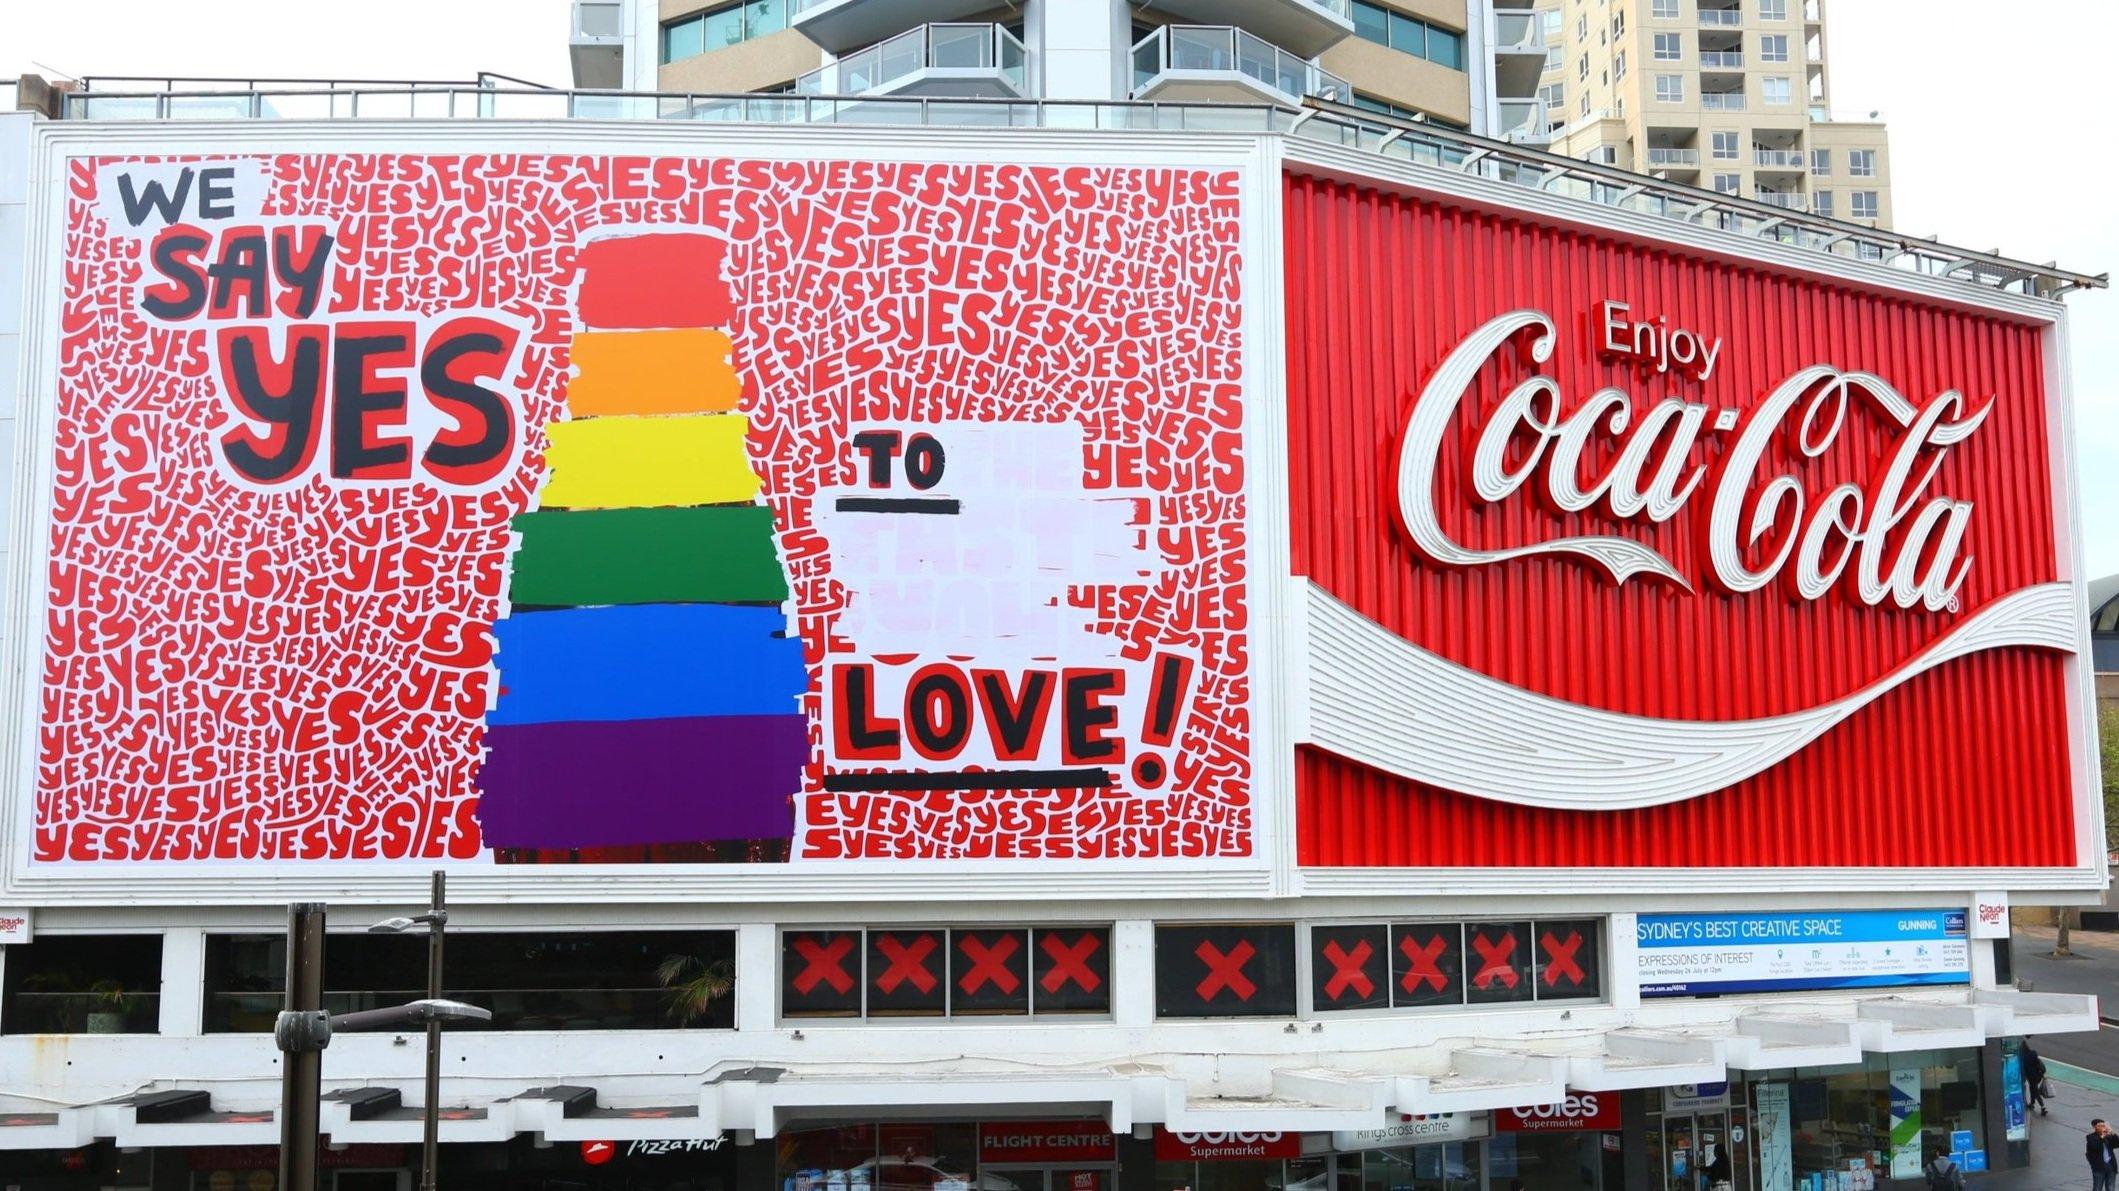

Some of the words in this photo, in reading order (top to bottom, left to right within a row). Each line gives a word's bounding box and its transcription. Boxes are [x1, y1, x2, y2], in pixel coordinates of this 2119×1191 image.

[301, 155, 350, 204] YES
[354, 155, 422, 182] YES
[416, 155, 486, 212] YES
[485, 155, 572, 182] YES
[576, 156, 686, 200] YES
[688, 159, 770, 190] YES
[804, 161, 873, 195] YES
[878, 163, 948, 206] YES
[950, 165, 1021, 200] YES
[1098, 169, 1141, 192] YES
[117, 167, 235, 226] WE
[348, 184, 412, 213] YES
[490, 179, 541, 211] YES
[626, 201, 676, 222] YES
[1021, 167, 1096, 224] YES
[1147, 170, 1208, 217] YES
[1210, 172, 1240, 242] YES
[680, 189, 759, 240] YES
[781, 199, 863, 268] YES
[903, 205, 956, 242] YES
[947, 198, 1023, 248] YES
[1066, 211, 1123, 253] YES
[338, 215, 418, 265] YES
[729, 230, 788, 276] YES
[861, 235, 928, 269] YES
[141, 224, 334, 321] SAY
[366, 247, 436, 276] YES
[929, 244, 1012, 292] YES
[1081, 256, 1124, 286] YES
[329, 266, 404, 313] YES
[452, 257, 516, 308] YES
[784, 265, 840, 310] YES
[867, 268, 924, 299] YES
[1013, 263, 1074, 306] YES
[1074, 285, 1130, 318] YES
[899, 289, 996, 356] YES
[993, 292, 1072, 346] YES
[1100, 310, 1172, 343] YES
[147, 330, 209, 377] YES
[989, 331, 1046, 379] YES
[1142, 328, 1196, 365] YES
[1603, 301, 1721, 380] Enjoy
[1190, 347, 1242, 380] YES
[168, 400, 227, 429] YES
[216, 317, 520, 485] YES
[830, 370, 890, 438] YES
[891, 374, 944, 423] YES
[946, 387, 996, 422] YES
[1081, 380, 1147, 421] YES
[1166, 382, 1242, 430] YES
[56, 413, 147, 486] YES
[1145, 410, 1212, 460] YES
[852, 430, 946, 490] TO
[1083, 439, 1172, 491] YES
[1173, 432, 1244, 494] YES
[53, 473, 154, 524] YES
[156, 462, 204, 505] YES
[209, 473, 254, 511] YES
[368, 483, 437, 515] YES
[149, 499, 212, 554] YES
[343, 509, 420, 548] YES
[411, 492, 509, 548] YES
[1159, 493, 1208, 525] YES
[52, 527, 95, 565] YES
[92, 516, 156, 553] YES
[441, 526, 509, 554] YES
[1158, 522, 1246, 566] YES
[99, 552, 137, 577] YES
[140, 544, 197, 589] YES
[197, 550, 274, 598] YES
[333, 543, 438, 593] YES
[438, 552, 504, 597] YES
[1184, 550, 1246, 590] YES
[50, 561, 120, 613] YES
[274, 569, 329, 605] YES
[48, 597, 136, 656] YES
[166, 592, 219, 623] YES
[218, 596, 283, 644] YES
[284, 588, 342, 636] YES
[344, 593, 401, 628] YES
[231, 646, 269, 663] YES
[274, 637, 314, 666] YES
[390, 612, 492, 669] YES
[45, 656, 104, 690] YES
[104, 640, 185, 708] YES
[214, 664, 276, 690] YES
[397, 662, 488, 720] YES
[43, 690, 92, 723] YES
[202, 685, 270, 726] YES
[272, 691, 367, 753] YES
[41, 722, 100, 764] YES
[167, 712, 215, 750] YES
[40, 753, 98, 789] YES
[102, 747, 145, 784] YES
[144, 738, 217, 786] YES
[279, 750, 331, 788] YES
[37, 788, 79, 825] YES
[80, 780, 126, 816] YES
[113, 786, 200, 824] YES
[200, 774, 261, 822] YES
[266, 784, 370, 829] YES
[838, 794, 911, 835] YES
[1101, 799, 1166, 830] YES
[193, 806, 264, 859] YES
[328, 802, 416, 860] YES
[410, 787, 481, 859] YES
[974, 800, 1047, 838] YES
[1139, 820, 1204, 858] YES
[36, 822, 130, 862] YES
[132, 823, 195, 860] YES
[262, 821, 328, 860] YES
[844, 830, 916, 859] YES
[963, 832, 1041, 859] YES
[1078, 827, 1137, 860] YES
[0, 916, 25, 925] laude
[1637, 920, 1702, 940] SYDNEY'S
[1706, 921, 1739, 938] BEST
[1741, 919, 1800, 937] CREATIVE
[1803, 918, 1842, 936] SPACE
[1898, 919, 1937, 931] GUNNING
[1979, 904, 2005, 914] Claude
[1979, 912, 1999, 923] Neon
[1638, 953, 1698, 967] EXPRESSIONS
[1701, 953, 1713, 965] OF
[1714, 952, 1754, 964] INTEREST
[983, 1135, 1043, 1148] FLIGHT
[1046, 1134, 1111, 1147] CENTRE
[1387, 1123, 1414, 1137] cross
[1415, 1120, 1450, 1134] centre
[1522, 1118, 1584, 1129] Supermarket
[1190, 1144, 1266, 1158] Supermarket
